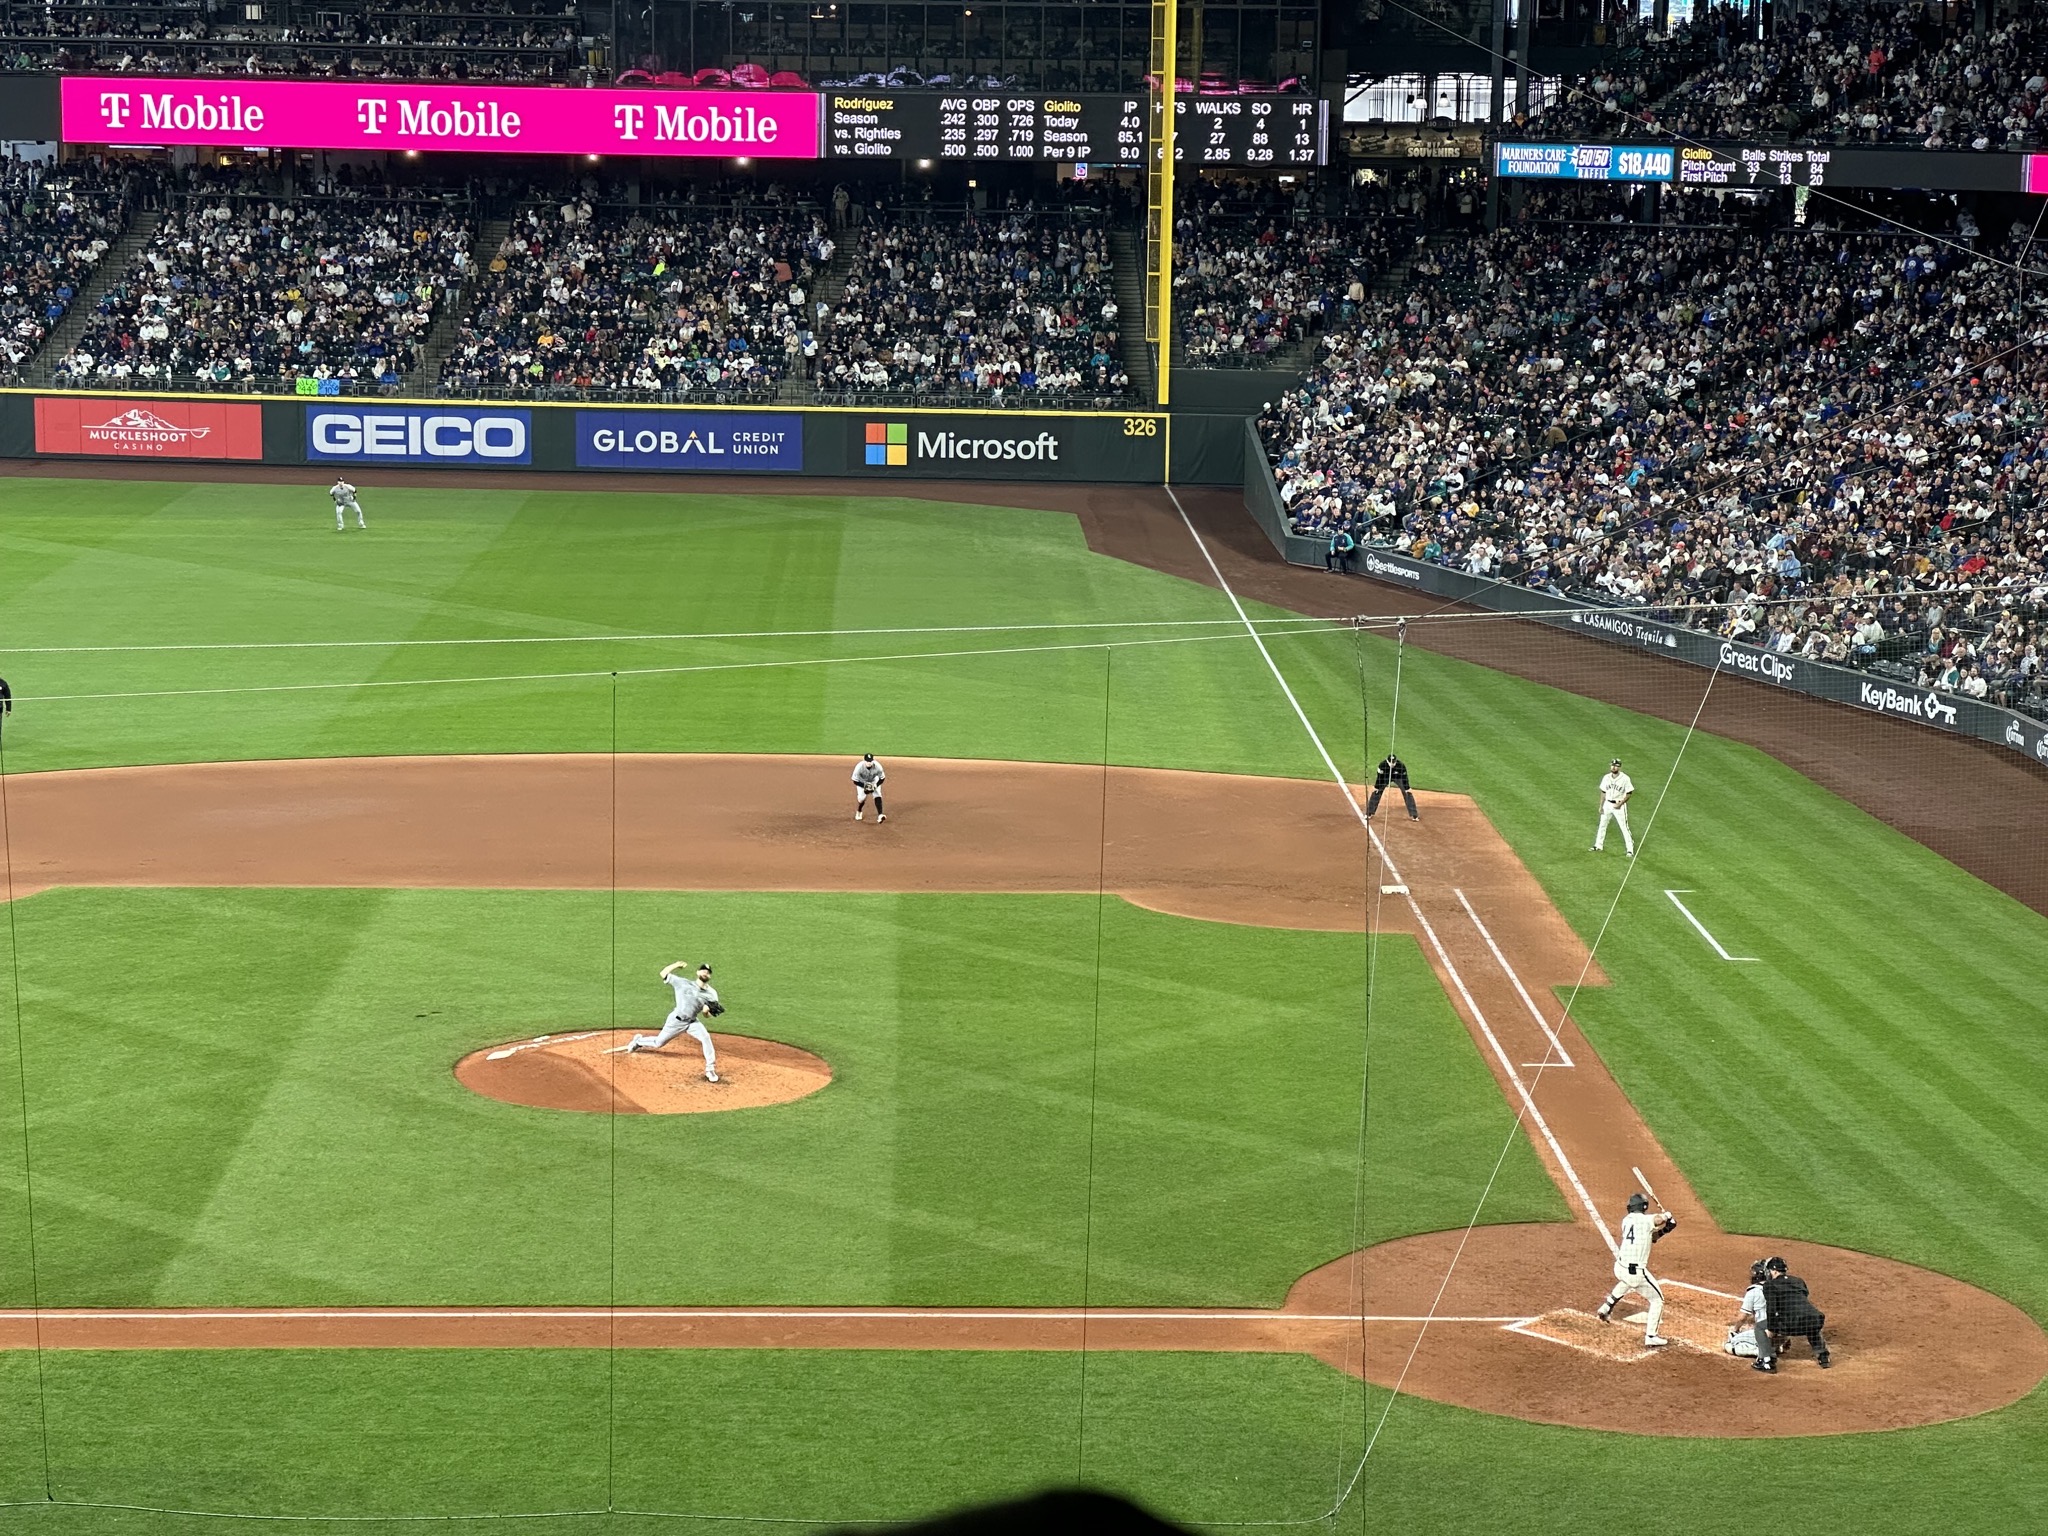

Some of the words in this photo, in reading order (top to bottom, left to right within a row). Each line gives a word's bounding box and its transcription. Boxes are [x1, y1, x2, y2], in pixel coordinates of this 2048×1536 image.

[100, 92, 130, 128] T
[139, 94, 264, 132] Mobile
[834, 97, 894, 112] Rodríguez
[940, 99, 967, 111] AVG
[972, 99, 1000, 112] OBP
[1007, 100, 1035, 112] OPS
[1044, 101, 1081, 112] Giolito
[1124, 102, 1138, 113] IP
[1196, 103, 1241, 114] WALKS
[1251, 103, 1272, 115] SO
[1292, 104, 1312, 115] HR
[357, 98, 387, 134] T
[396, 99, 521, 138] Mobile
[614, 104, 644, 140] T
[653, 105, 778, 143] Mobile
[834, 112, 878, 124] Season
[941, 114, 966, 125] .242
[974, 114, 999, 126] .300
[1009, 115, 1034, 126] .726
[1044, 116, 1078, 128] Today
[1120, 117, 1140, 128] 4.0
[1214, 118, 1222, 129] 2
[1256, 118, 1265, 129] 4
[1300, 119, 1306, 129] 1
[834, 129, 851, 139] vs.
[854, 127, 901, 141] Righties
[941, 129, 966, 140] .235
[974, 130, 999, 141] .297
[1009, 130, 1034, 142] .719
[1044, 131, 1088, 142] Season
[1118, 132, 1143, 143] 85.1
[1210, 133, 1225, 144] 27
[1253, 133, 1268, 144] 88
[1295, 134, 1310, 145] 13
[834, 144, 851, 154] vs.
[854, 143, 892, 155] Giolito
[941, 145, 966, 156] .500
[974, 145, 999, 156] .500
[1009, 145, 1034, 157] 1.000
[1043, 146, 1064, 158] Per
[1066, 146, 1075, 158] 9
[1078, 147, 1091, 158] IP
[1120, 147, 1140, 158] 9.0
[1204, 148, 1231, 159] 2.85
[1247, 148, 1273, 160] 9.28
[1289, 149, 1314, 161] 1.37
[1407, 147, 1460, 158] SOUVENIRS
[1502, 147, 1544, 162] MARINERS
[1545, 149, 1567, 162] CARE
[1682, 148, 1713, 160] Giolito
[1742, 149, 1766, 161] Balls
[1769, 150, 1803, 162] Strikes
[1806, 151, 1830, 163] Total
[1579, 149, 1609, 167] 50/50
[1618, 152, 1671, 177] $18,440
[1508, 161, 1560, 174] FOUNDATION
[1578, 168, 1609, 179] RAFFLE
[1681, 161, 1705, 171] Pitch
[1707, 161, 1736, 172] Count
[1747, 162, 1760, 172] 33
[1779, 163, 1792, 173] 51
[1810, 163, 1823, 174] 84
[1680, 171, 1702, 182] First
[1703, 172, 1727, 183] Pitch
[1749, 173, 1757, 184] 7
[1779, 174, 1792, 185] 13
[1809, 175, 1823, 186] 20
[1123, 418, 1157, 436] 326
[89, 430, 187, 442] MUCKLESHOOT
[312, 413, 526, 458] GEICO
[593, 429, 725, 454] GLOBAL
[733, 432, 785, 442] CREDIT
[114, 443, 163, 451] CASINO
[733, 445, 779, 455] UNION
[917, 431, 1059, 461] Microsoft
[1583, 612, 1633, 637] CASAMIGOS
[1635, 626, 1663, 646] Tequila
[1720, 642, 1759, 672] Great
[1760, 653, 1793, 684] Clips
[1861, 681, 1922, 716] KeyBank
